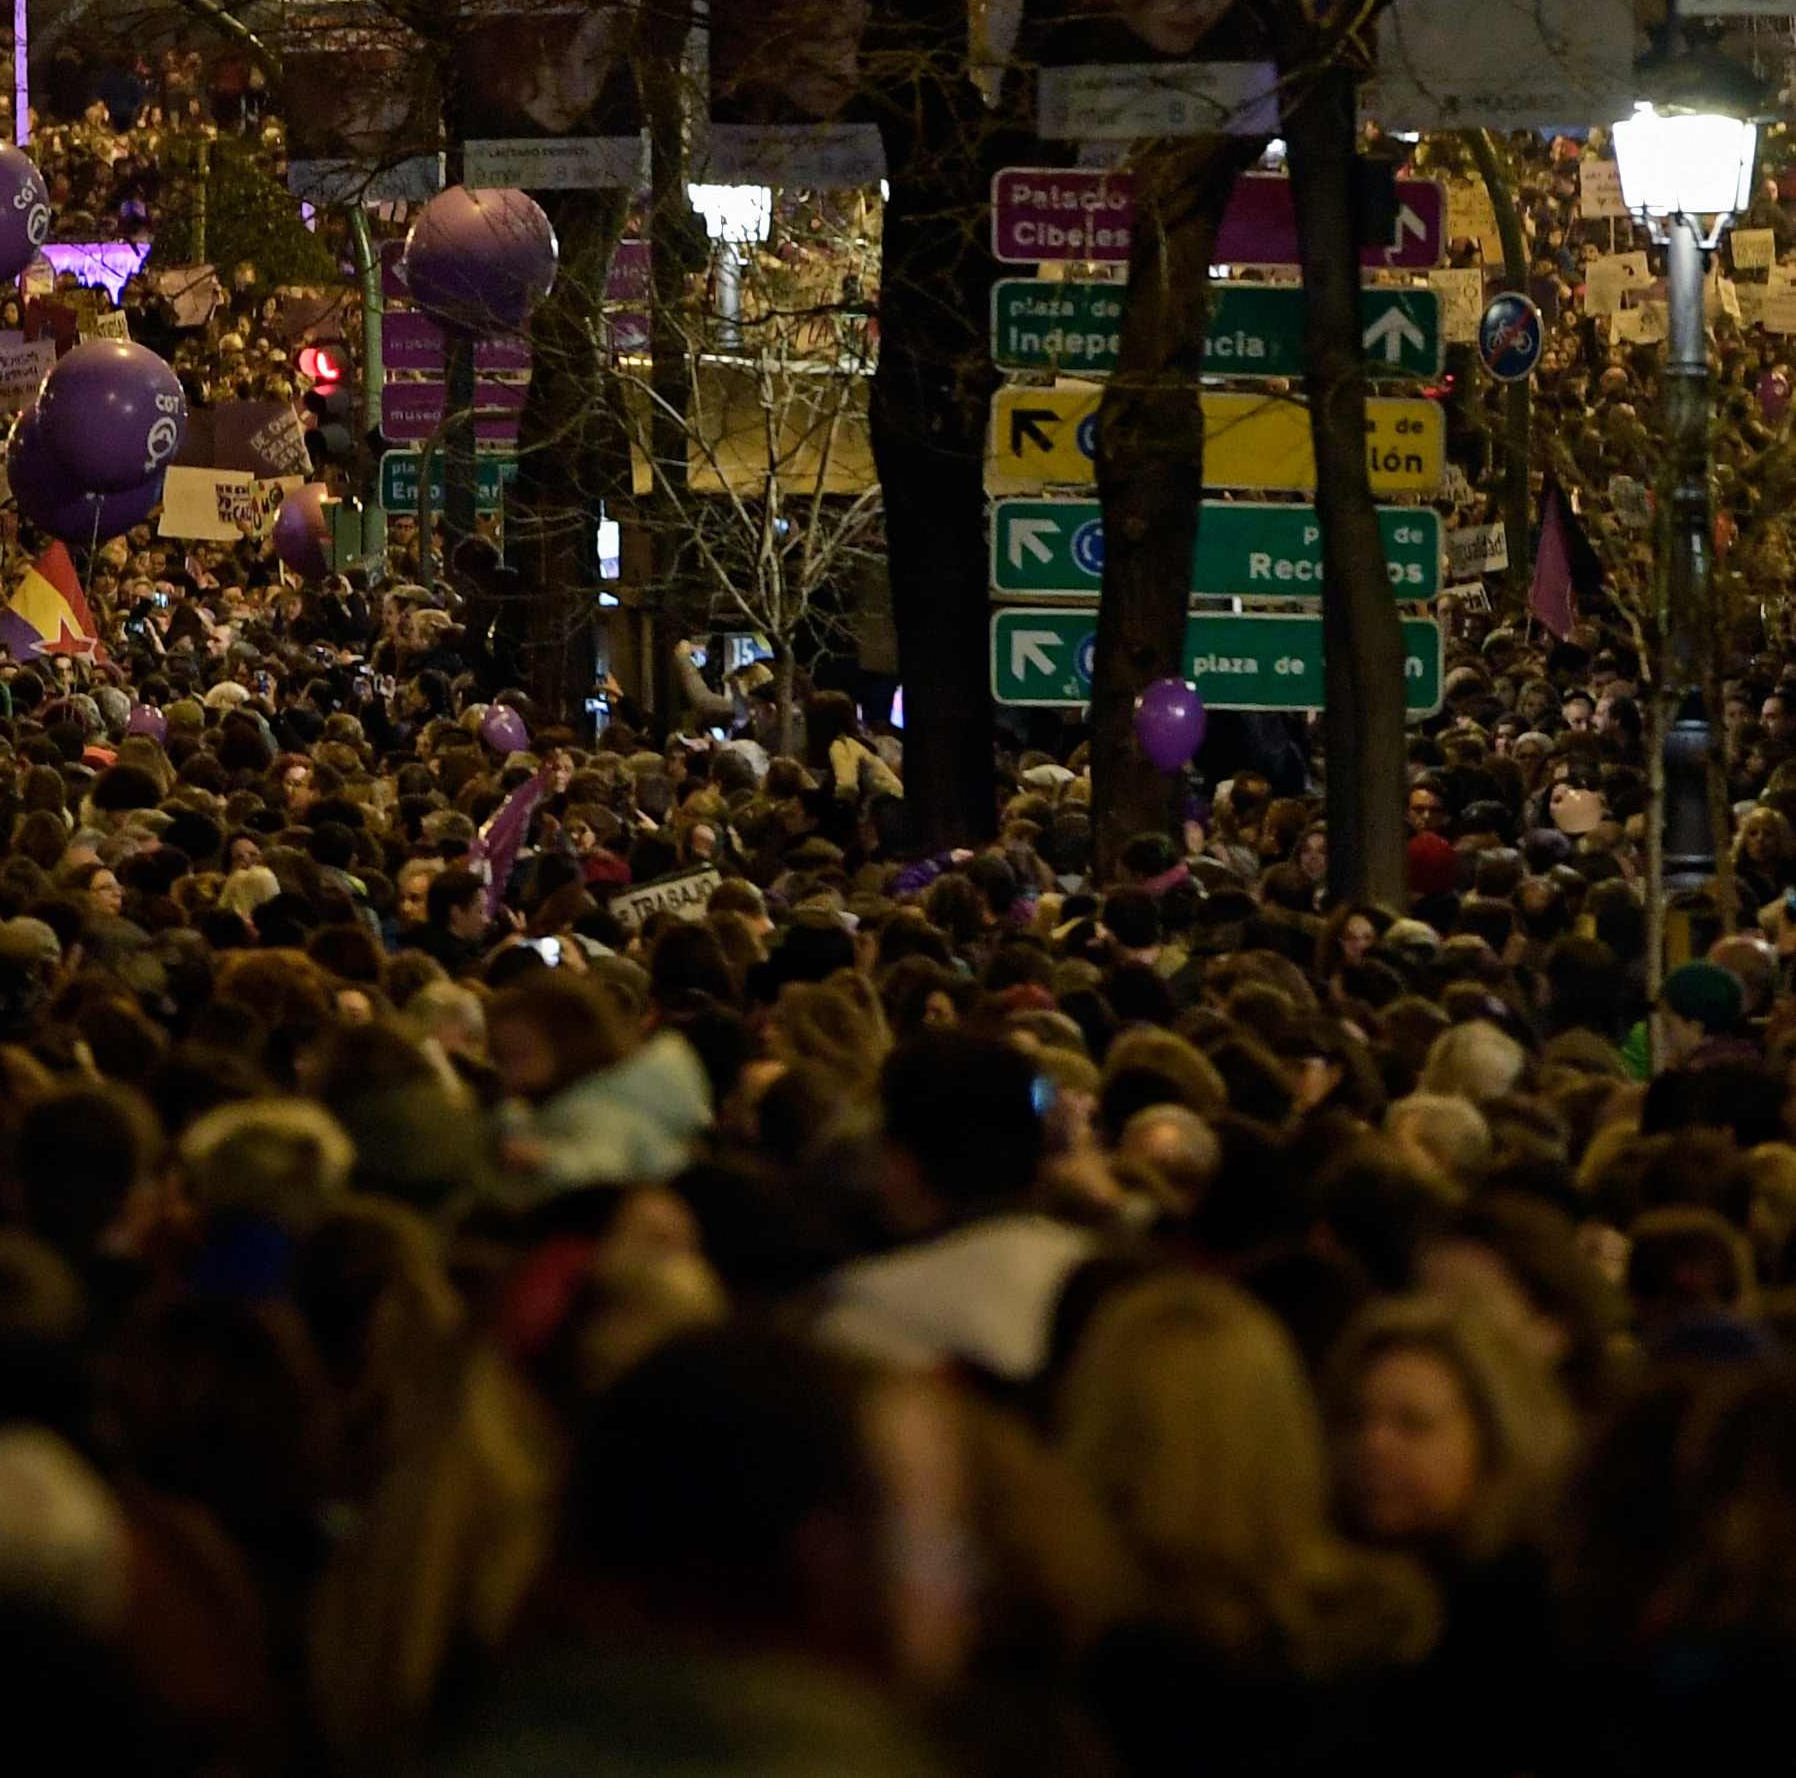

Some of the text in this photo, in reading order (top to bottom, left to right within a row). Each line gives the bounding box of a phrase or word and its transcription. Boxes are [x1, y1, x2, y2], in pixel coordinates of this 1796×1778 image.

[13, 179, 38, 209] CGT
[1011, 184, 1129, 212] Palacio
[1013, 220, 1131, 246] Cibeles
[1009, 296, 1119, 319] plaza de
[1009, 327, 1265, 358] Indepcia
[155, 393, 179, 414] CGT
[390, 408, 442, 422] museo
[1395, 418, 1424, 435] de
[1370, 448, 1424, 473] lón
[1394, 526, 1425, 545] de
[1247, 553, 1425, 584] Recos
[1193, 654, 1305, 676] plaza de
